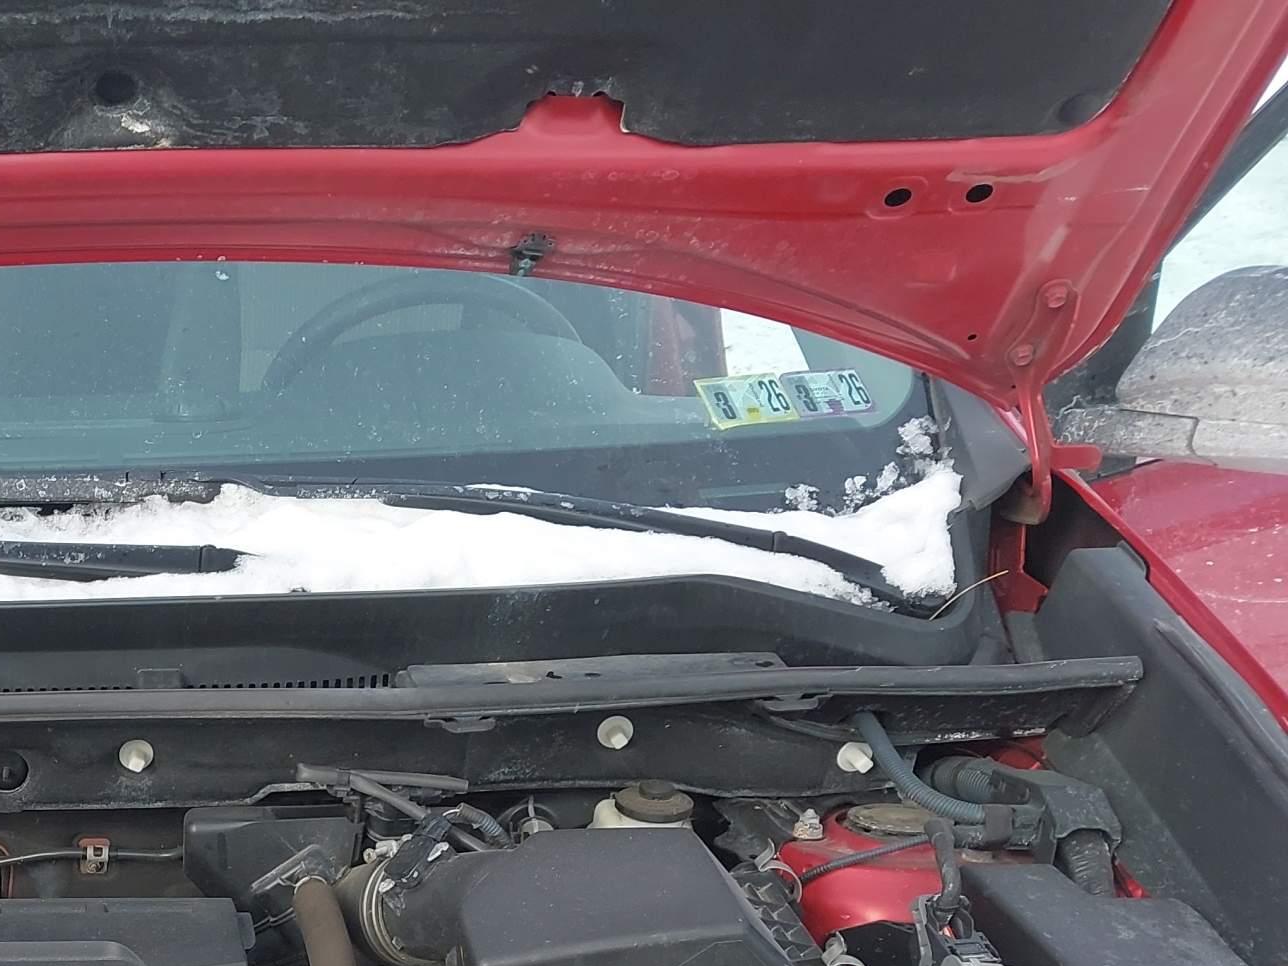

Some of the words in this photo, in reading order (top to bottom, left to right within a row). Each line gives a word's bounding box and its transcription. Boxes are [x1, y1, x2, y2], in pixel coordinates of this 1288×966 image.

[714, 391, 737, 420] 3
[758, 379, 791, 413] 26
[795, 384, 818, 412] 3
[838, 373, 871, 406] 26
